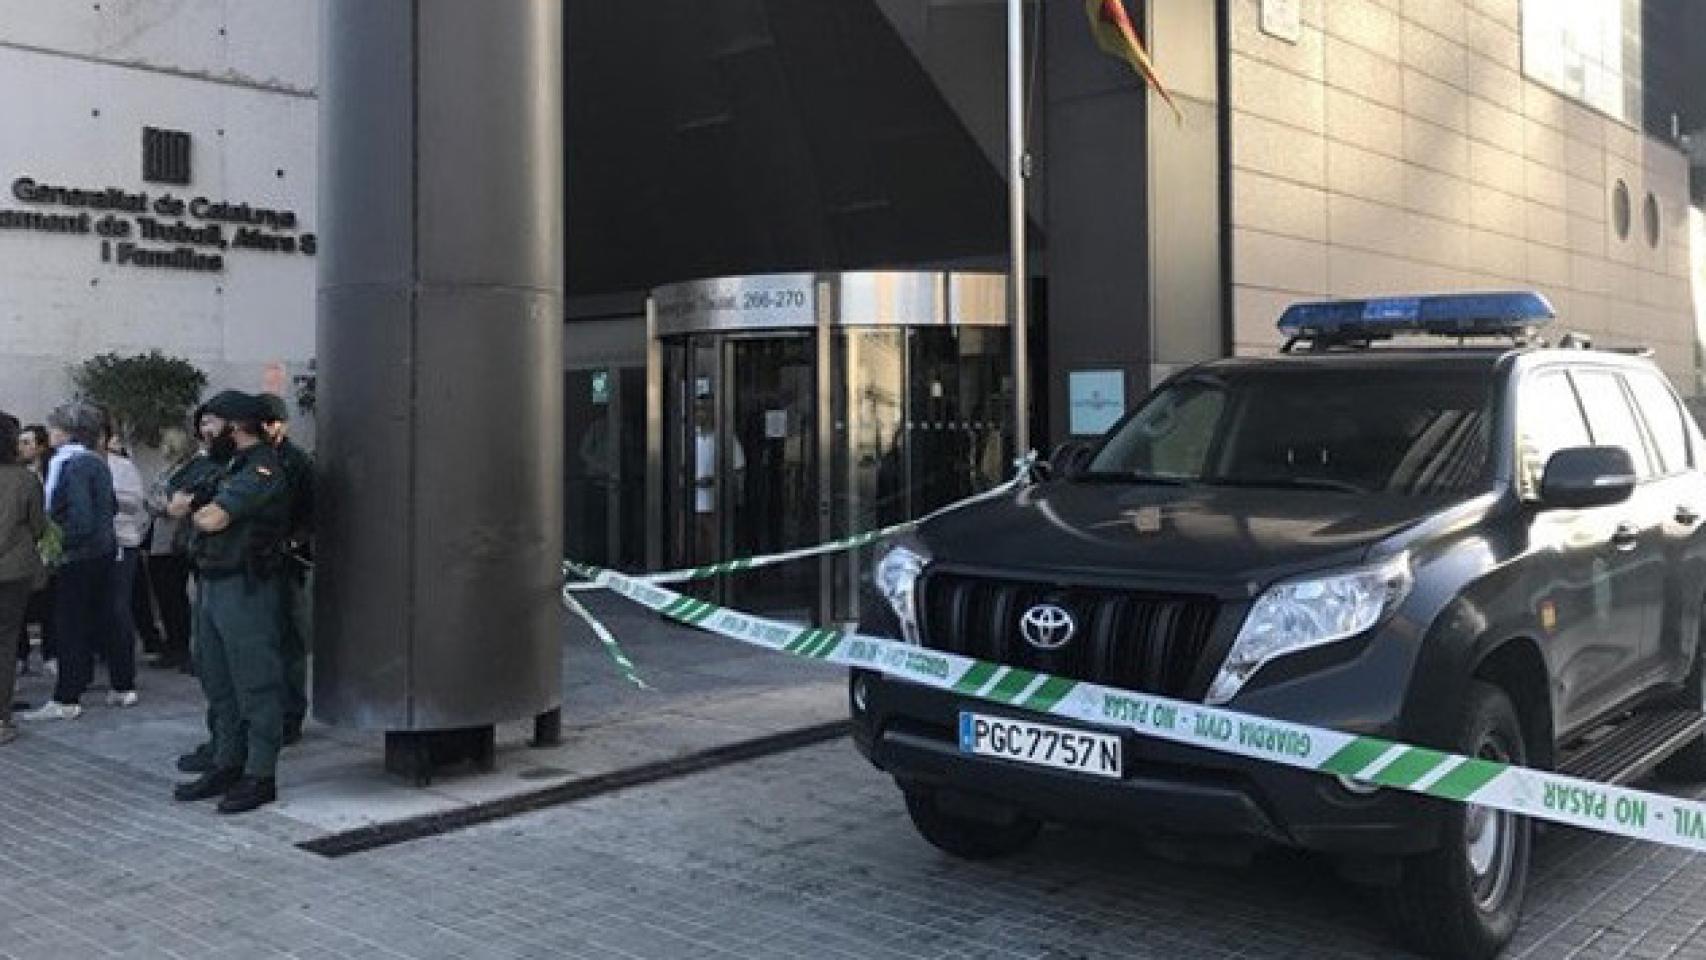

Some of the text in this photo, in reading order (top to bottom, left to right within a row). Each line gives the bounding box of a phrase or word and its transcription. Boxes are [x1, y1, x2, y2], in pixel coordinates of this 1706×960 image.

[12, 177, 296, 229] Generalitat de Catalunya
[96, 215, 130, 237] de
[975, 719, 1118, 772] PGC7757N
[1544, 781, 1607, 820] PASAR
[1616, 795, 1646, 827] NO
